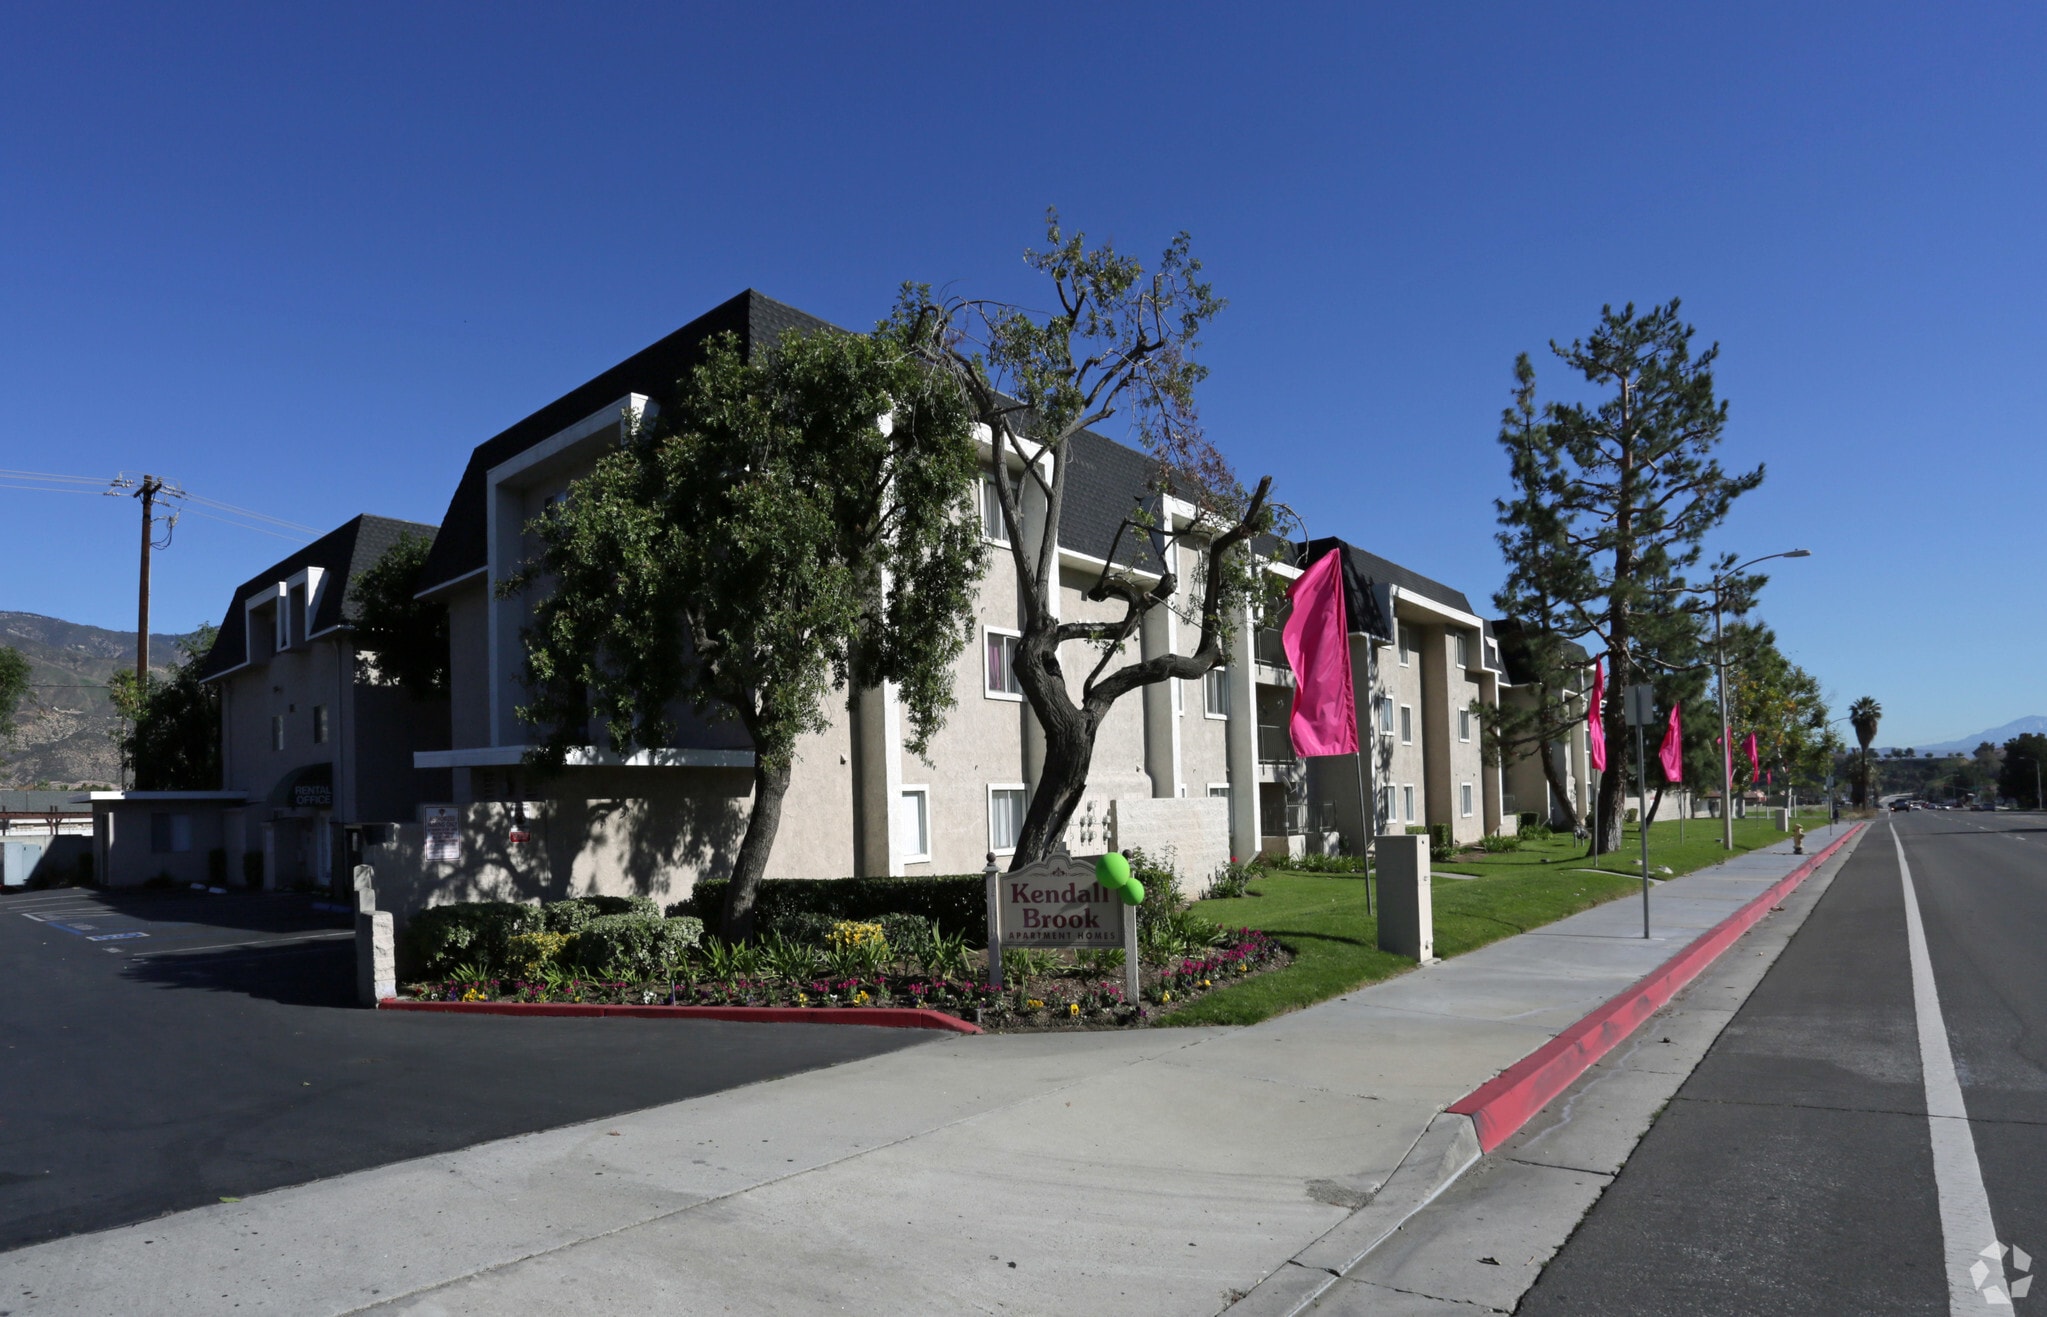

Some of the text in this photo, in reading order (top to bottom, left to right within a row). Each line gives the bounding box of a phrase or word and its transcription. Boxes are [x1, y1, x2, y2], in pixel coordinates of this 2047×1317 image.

[295, 785, 332, 795] RENTAL
[296, 795, 331, 805] OFFICE
[1011, 882, 1109, 904] Kendall
[1023, 908, 1100, 929] Brook
[1008, 931, 1116, 940] APARTMENT HOMES
